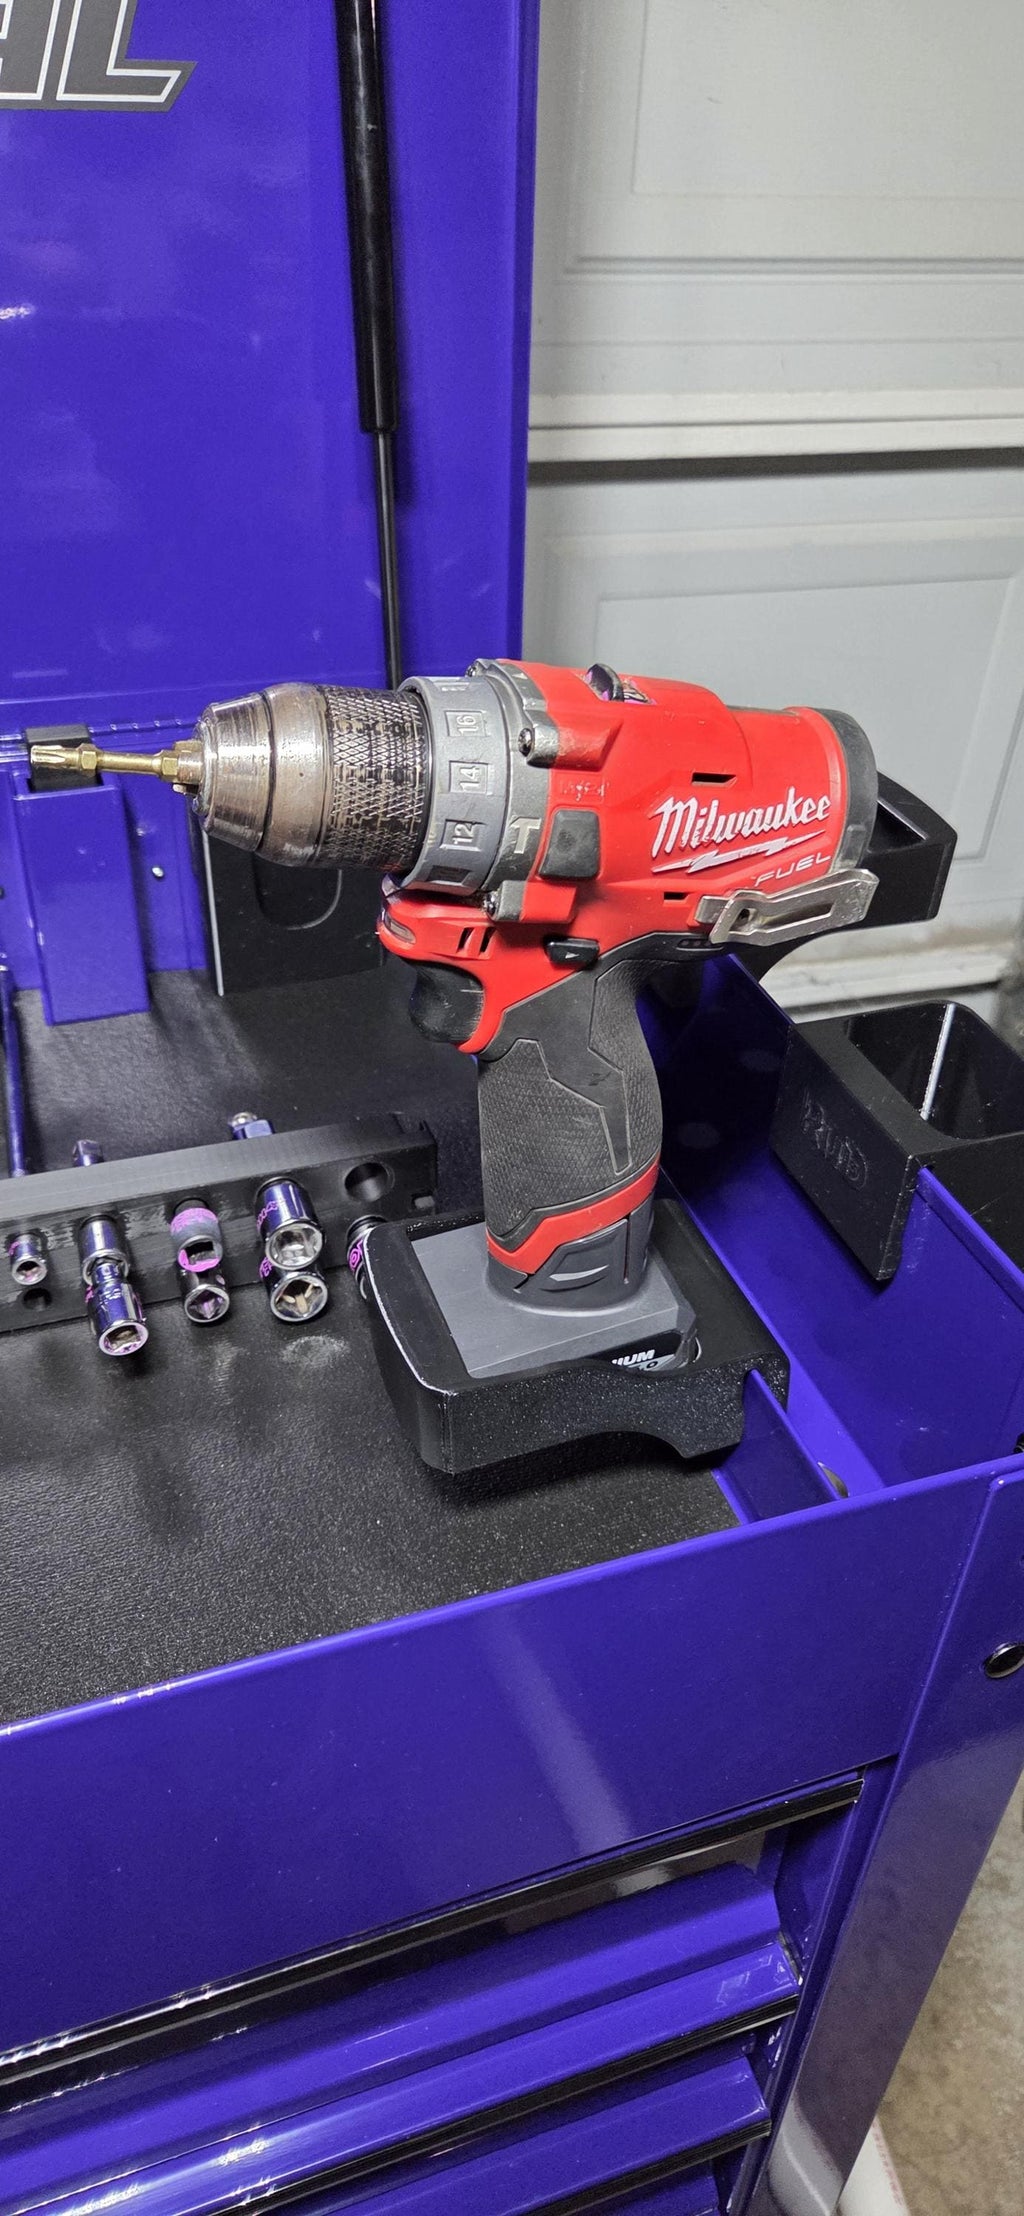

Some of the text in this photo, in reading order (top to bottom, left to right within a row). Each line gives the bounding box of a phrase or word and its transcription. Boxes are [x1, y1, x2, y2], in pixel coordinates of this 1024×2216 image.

[456, 714, 479, 737] 16
[459, 766, 481, 792] 14
[452, 822, 474, 845] 12
[648, 786, 831, 858] Milwaukee
[754, 852, 832, 887] FUEL
